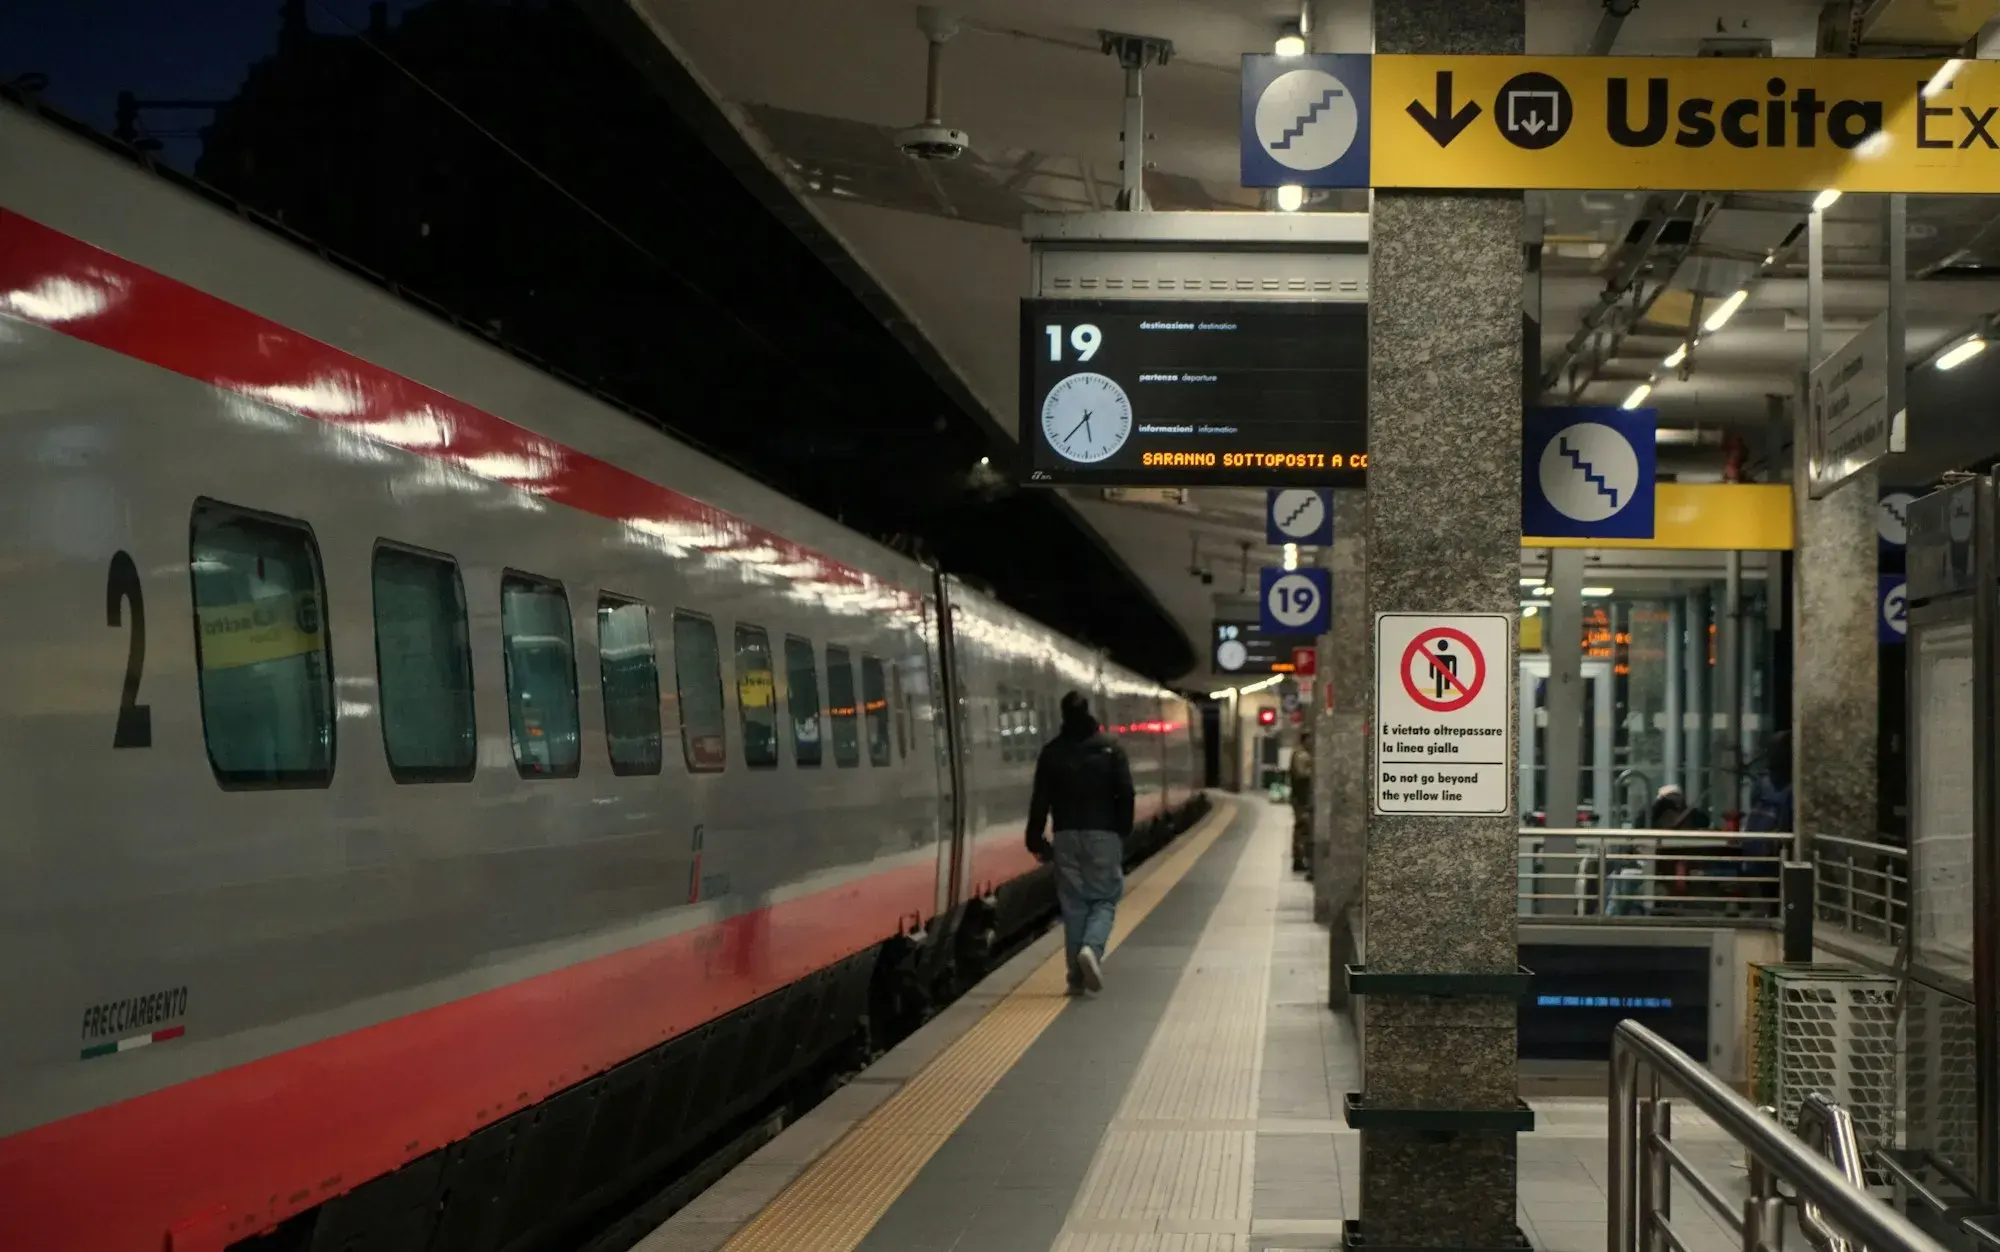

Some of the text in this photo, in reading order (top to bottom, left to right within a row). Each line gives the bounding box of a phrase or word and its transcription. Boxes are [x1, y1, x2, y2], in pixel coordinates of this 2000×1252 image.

[1606, 77, 2000, 149] Uscita Ex
[1140, 321, 1238, 330] destinazione destination
[1045, 323, 1102, 362] 19
[1139, 373, 1218, 382] partenza departure
[1139, 424, 1239, 433] informazioni information
[1142, 452, 1216, 466] SARANNO
[1223, 453, 1325, 468] SOTTOPOSTI
[1332, 454, 1343, 468] A
[1276, 587, 1314, 613] 19
[106, 549, 152, 749] 2
[1391, 725, 1430, 736] vietato
[1433, 725, 1503, 738] oltrepassare
[1383, 742, 1459, 755] la linea gialla
[1383, 773, 1478, 786] Do not go beyond
[1382, 790, 1462, 802] the yellow line
[82, 986, 188, 1041] FRECCIARGENTO
